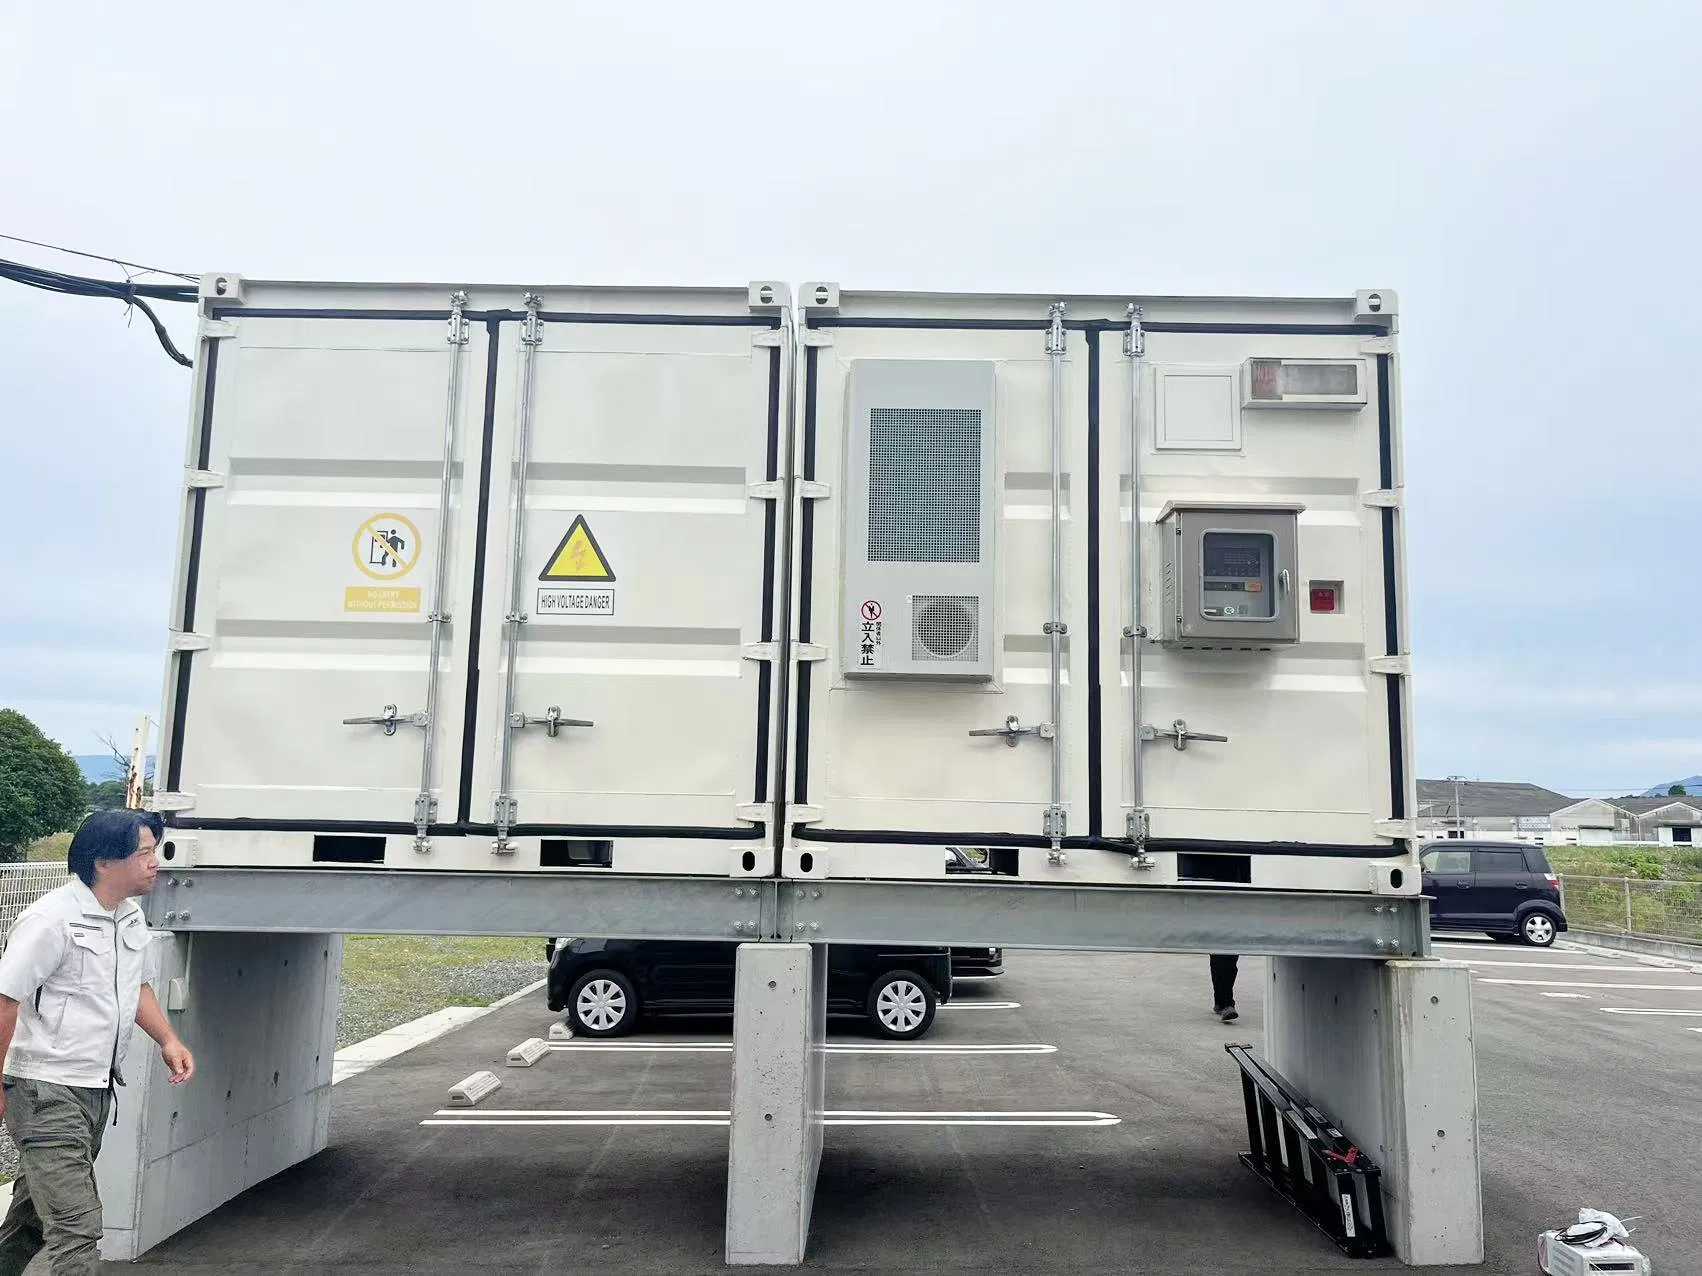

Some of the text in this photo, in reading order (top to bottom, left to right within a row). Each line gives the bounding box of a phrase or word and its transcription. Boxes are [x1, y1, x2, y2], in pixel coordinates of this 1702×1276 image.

[541, 594, 610, 609] HIGH VOLTAGE DANGER
[860, 621, 875, 666] 立入禁止
